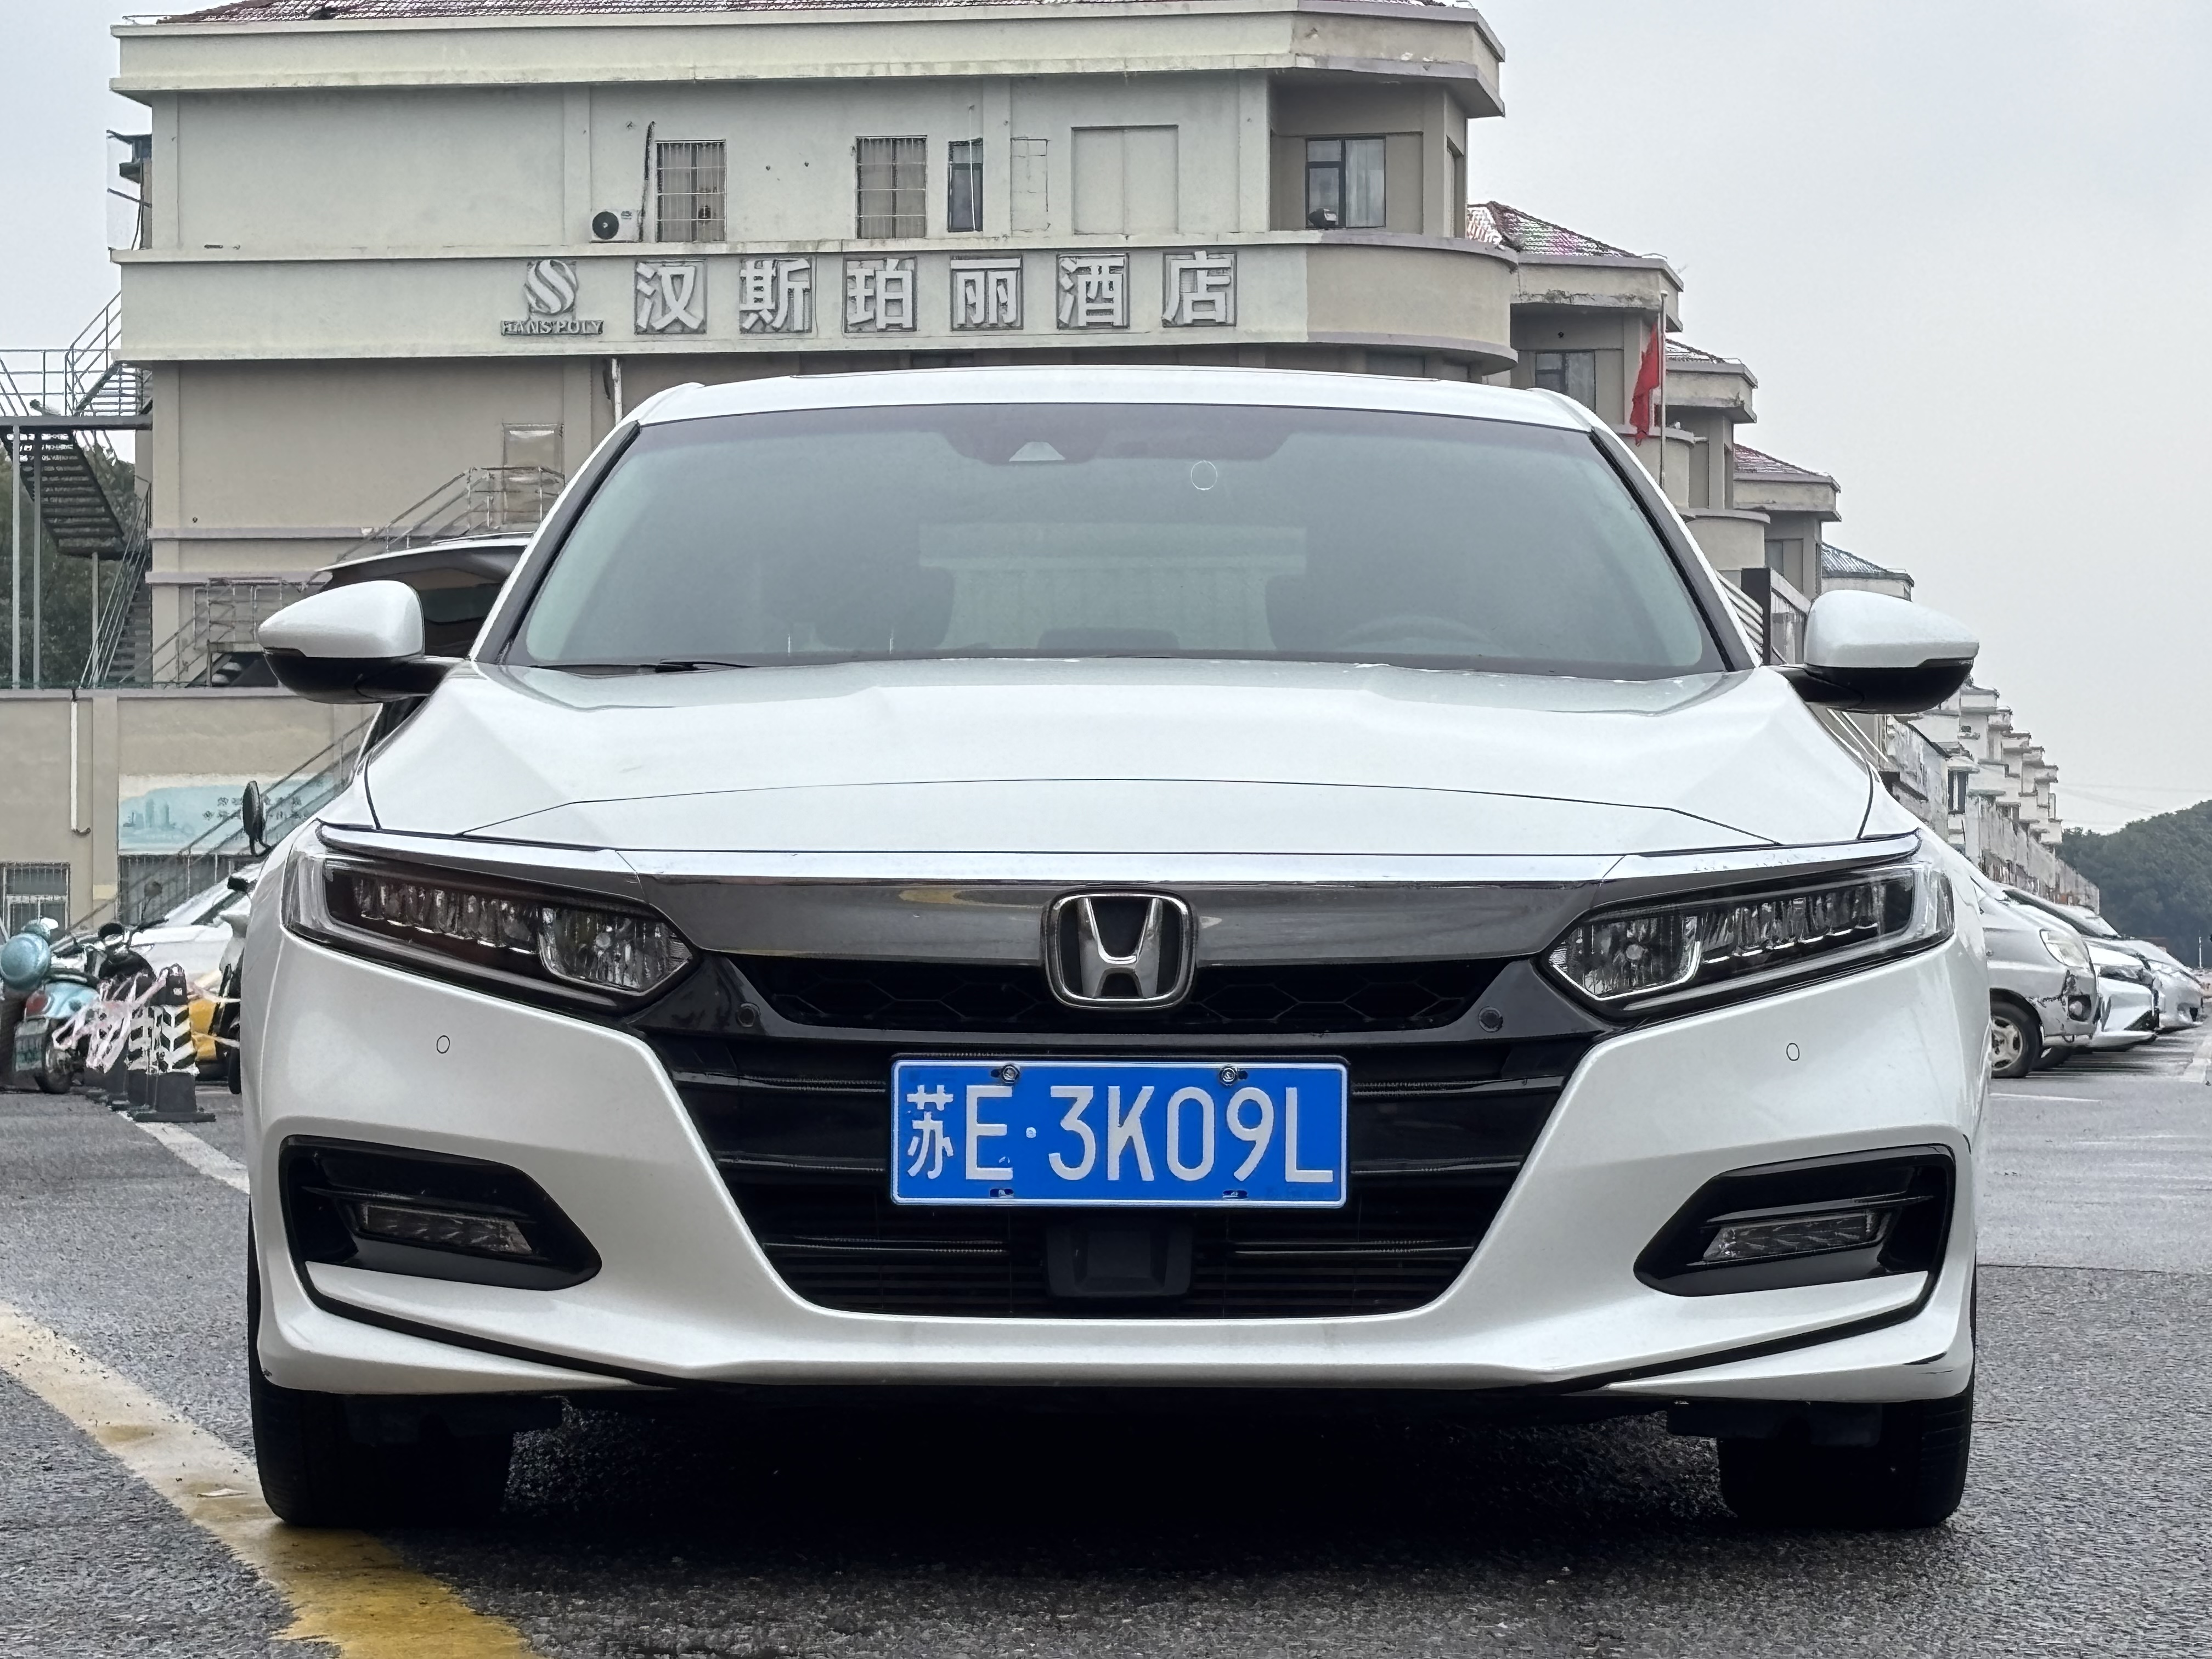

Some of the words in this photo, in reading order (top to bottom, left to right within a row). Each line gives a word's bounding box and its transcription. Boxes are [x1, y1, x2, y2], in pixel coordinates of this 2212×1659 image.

[636, 251, 1233, 333] 汉斯珀丽酒店
